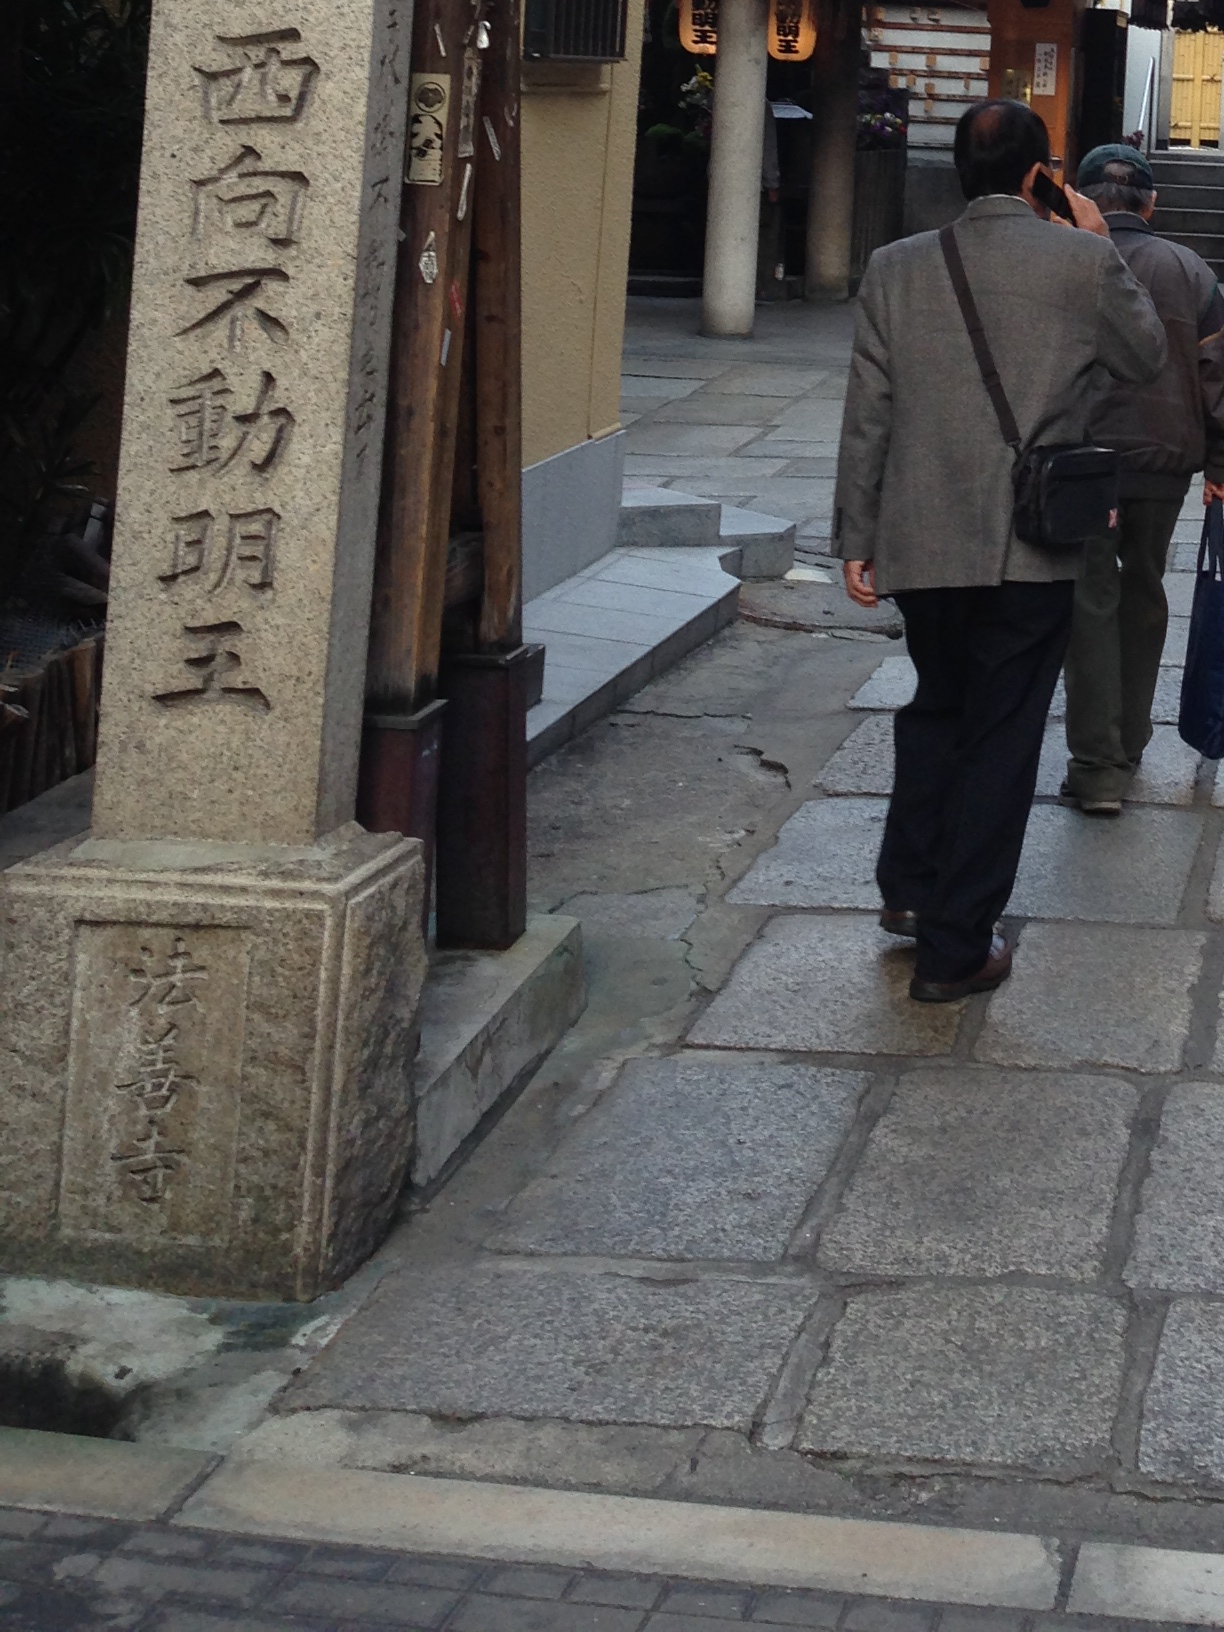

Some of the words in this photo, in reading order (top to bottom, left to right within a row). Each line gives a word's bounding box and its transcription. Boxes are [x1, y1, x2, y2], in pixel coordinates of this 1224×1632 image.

[150, 25, 323, 714] 西向不動明王
[110, 934, 210, 1206] 法善寺
